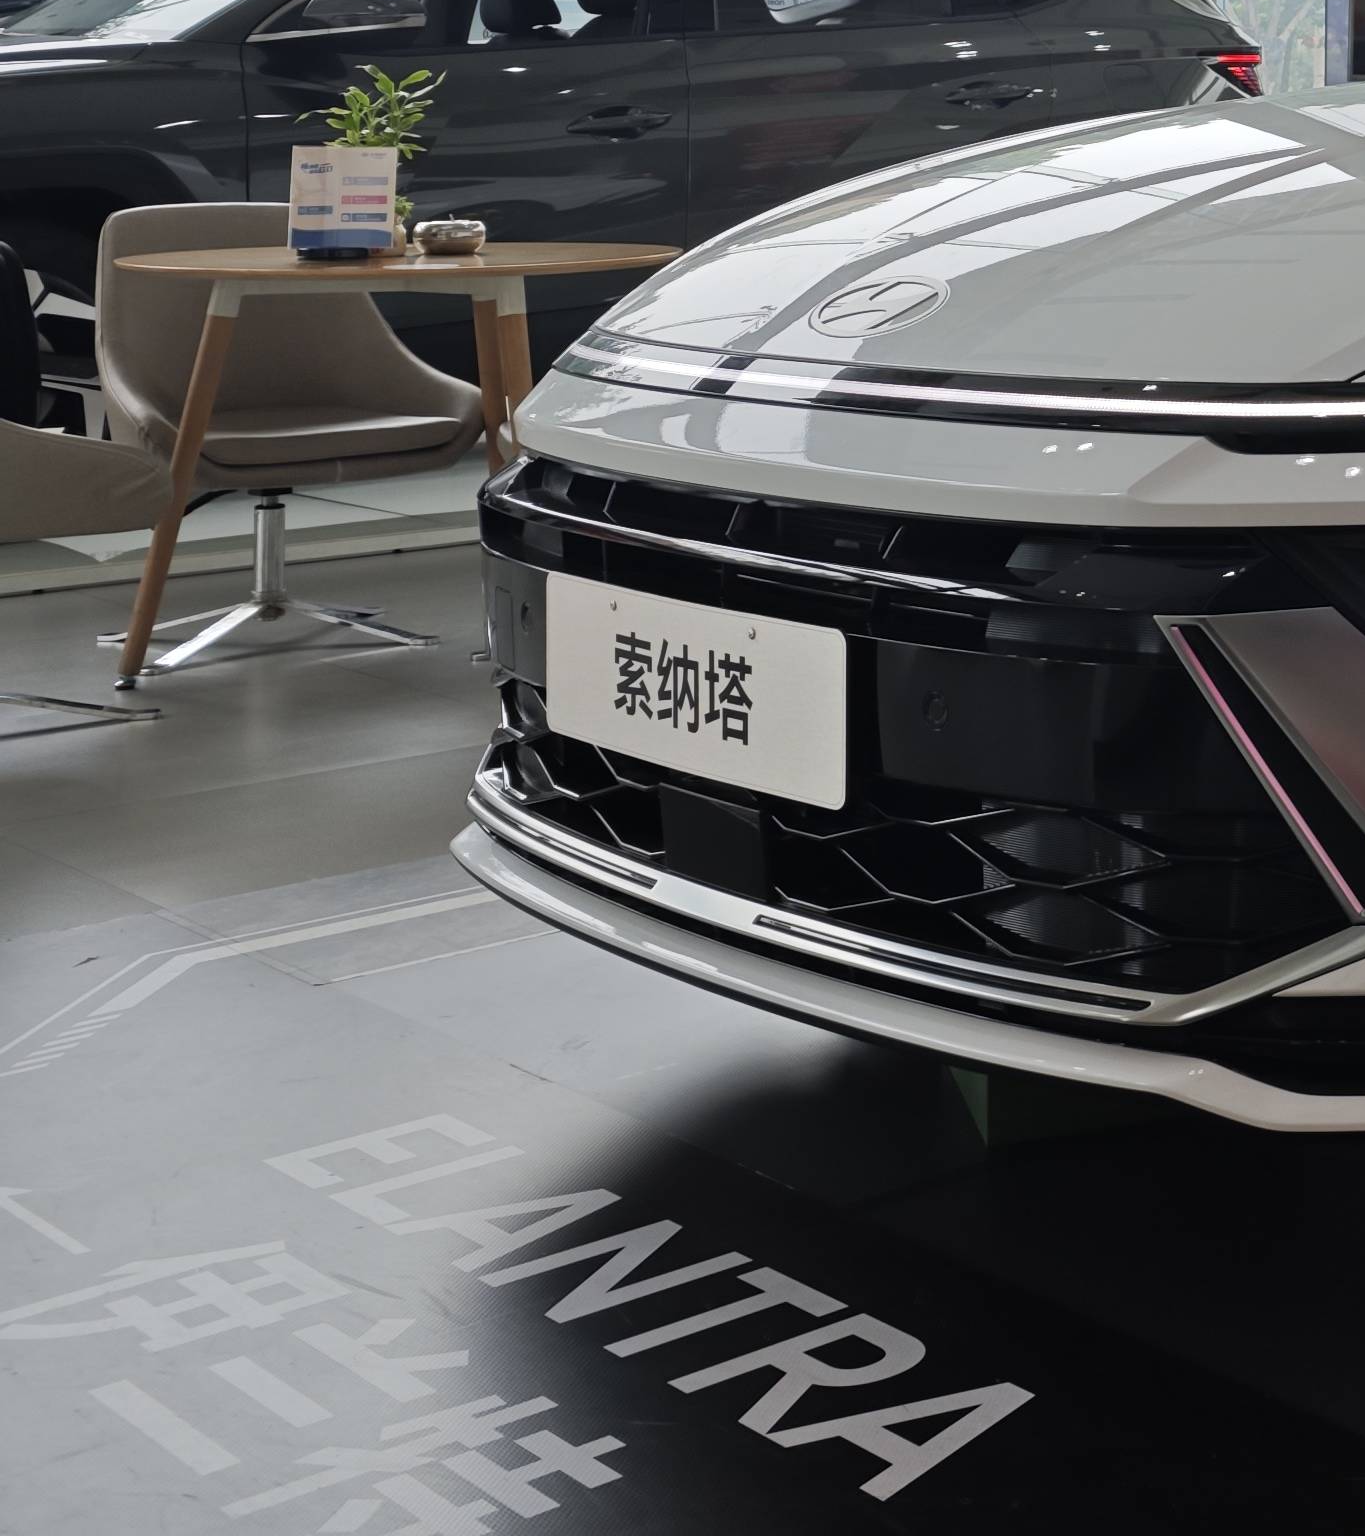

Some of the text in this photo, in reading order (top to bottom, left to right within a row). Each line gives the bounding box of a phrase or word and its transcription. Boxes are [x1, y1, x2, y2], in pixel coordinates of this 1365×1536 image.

[612, 631, 753, 747] 索纳塔
[0, 1240, 624, 1536] 伊兰特
[262, 1112, 1036, 1502] ELANTRA
